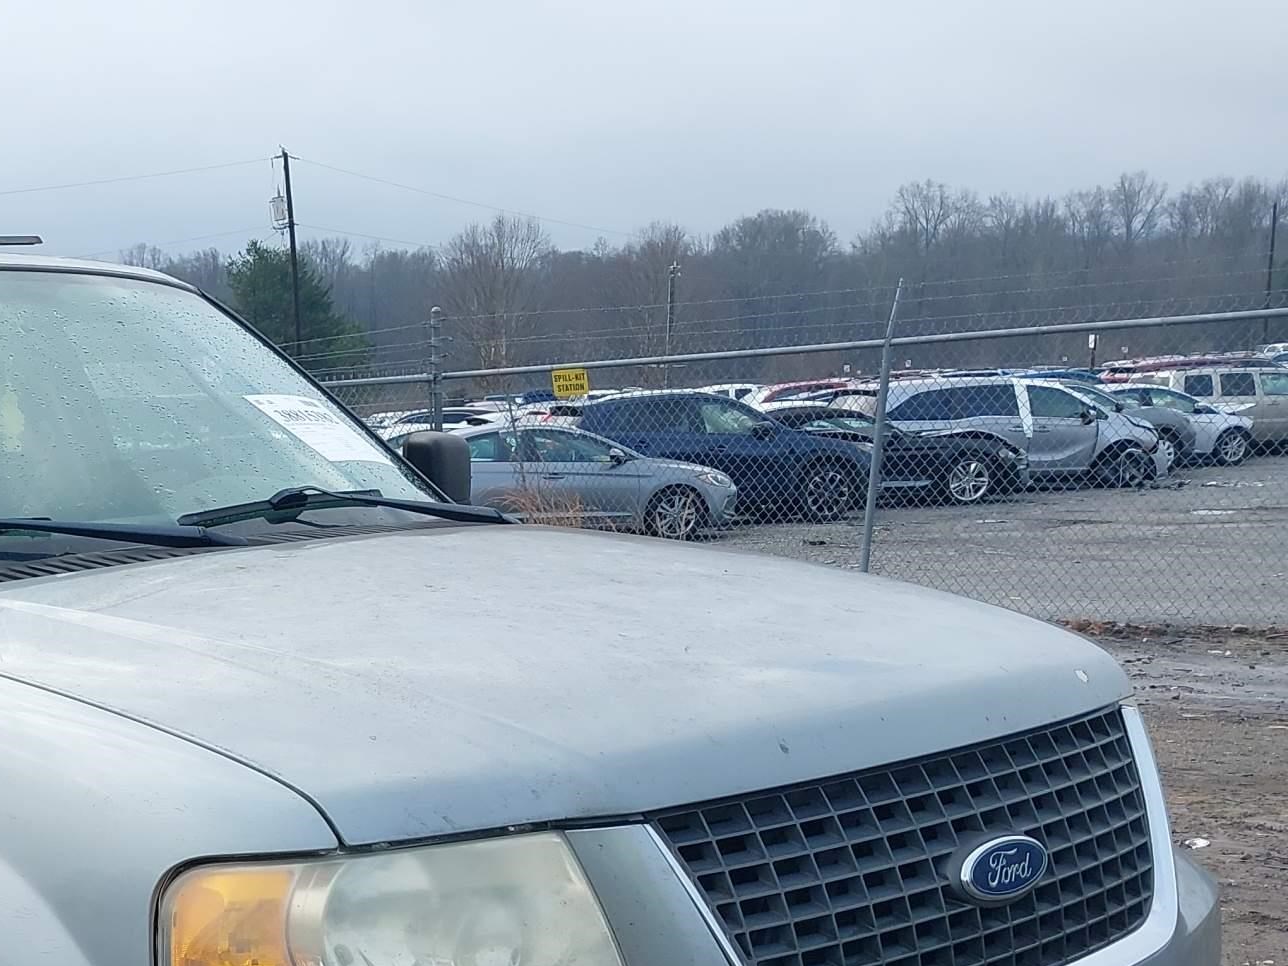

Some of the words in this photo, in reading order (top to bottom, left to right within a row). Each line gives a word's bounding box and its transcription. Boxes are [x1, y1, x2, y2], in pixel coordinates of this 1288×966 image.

[553, 373, 585, 382] SPILL-KIT
[557, 382, 585, 392] STATION
[988, 847, 1032, 888] Ford
